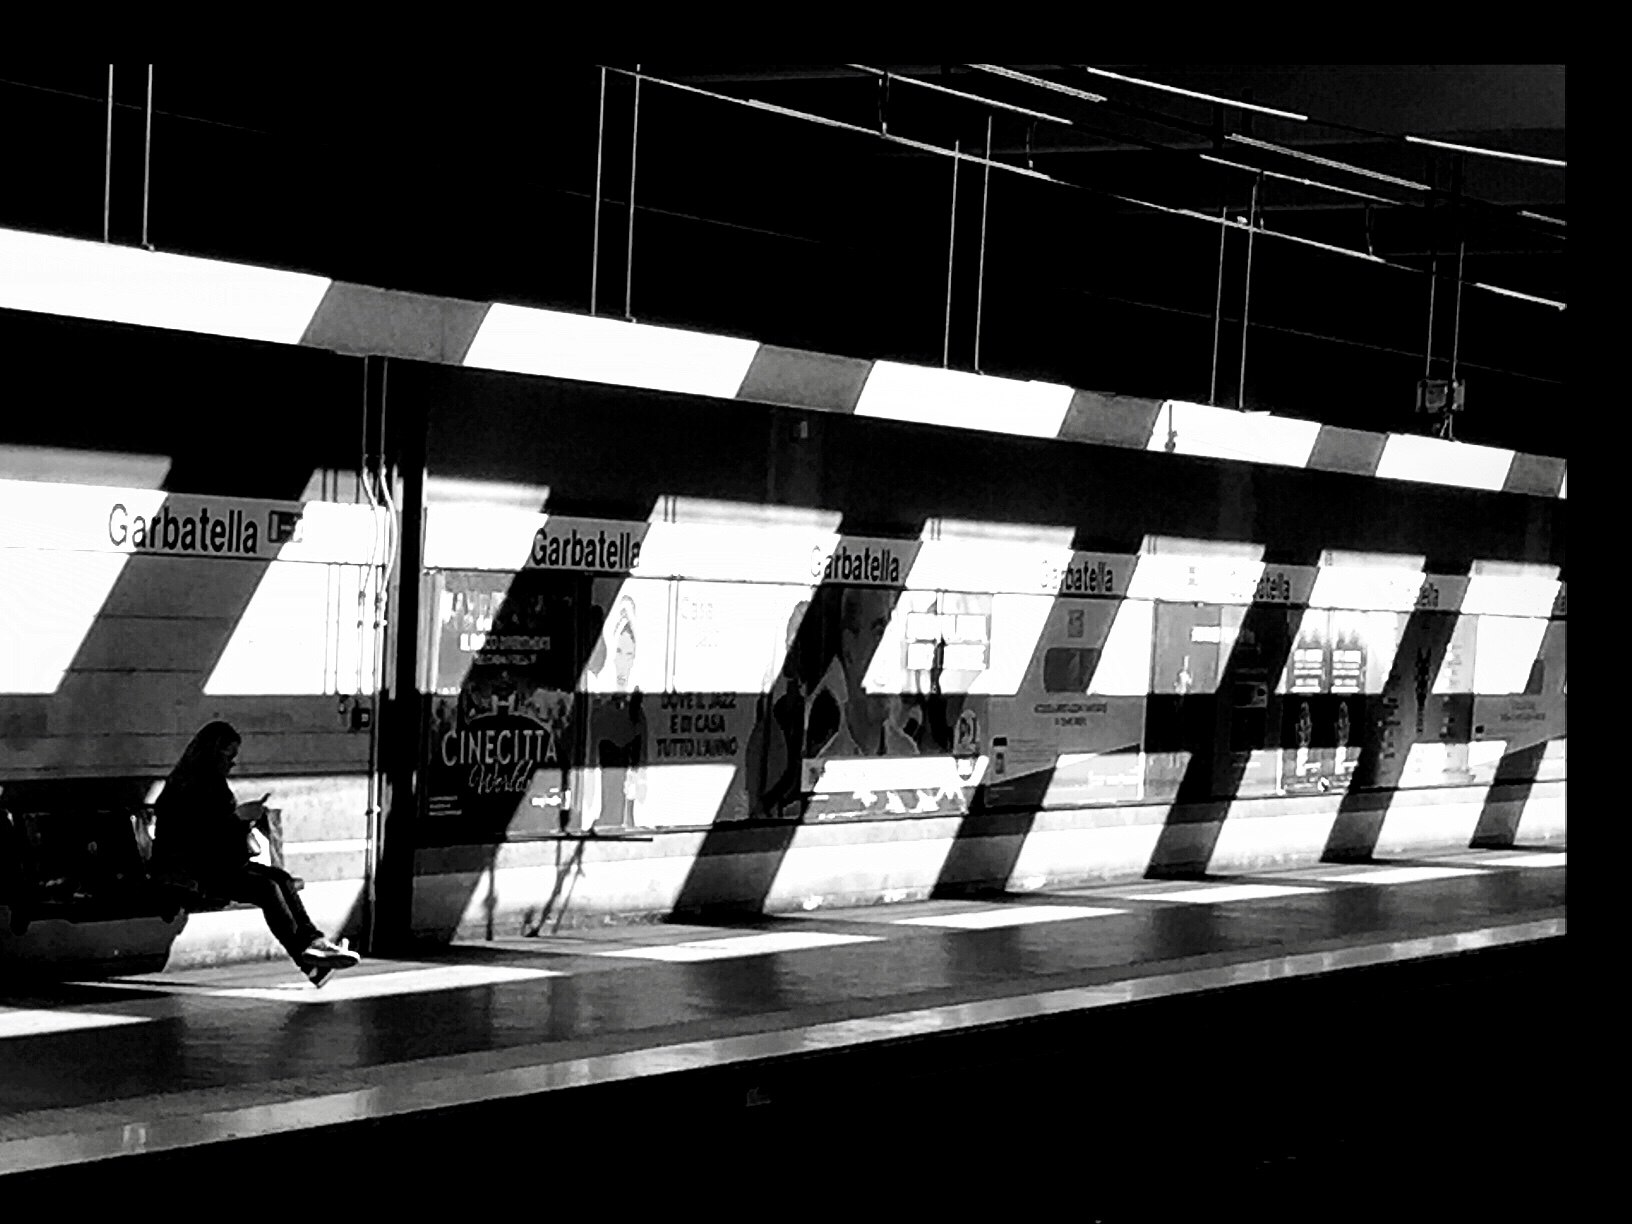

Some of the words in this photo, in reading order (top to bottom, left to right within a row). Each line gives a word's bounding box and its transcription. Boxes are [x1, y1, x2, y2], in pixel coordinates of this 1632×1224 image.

[109, 503, 258, 554] Garbatella
[532, 527, 640, 569] Garbatella
[810, 546, 900, 582] Garbatella
[694, 714, 726, 733] CASA
[656, 738, 695, 758] TUTTO
